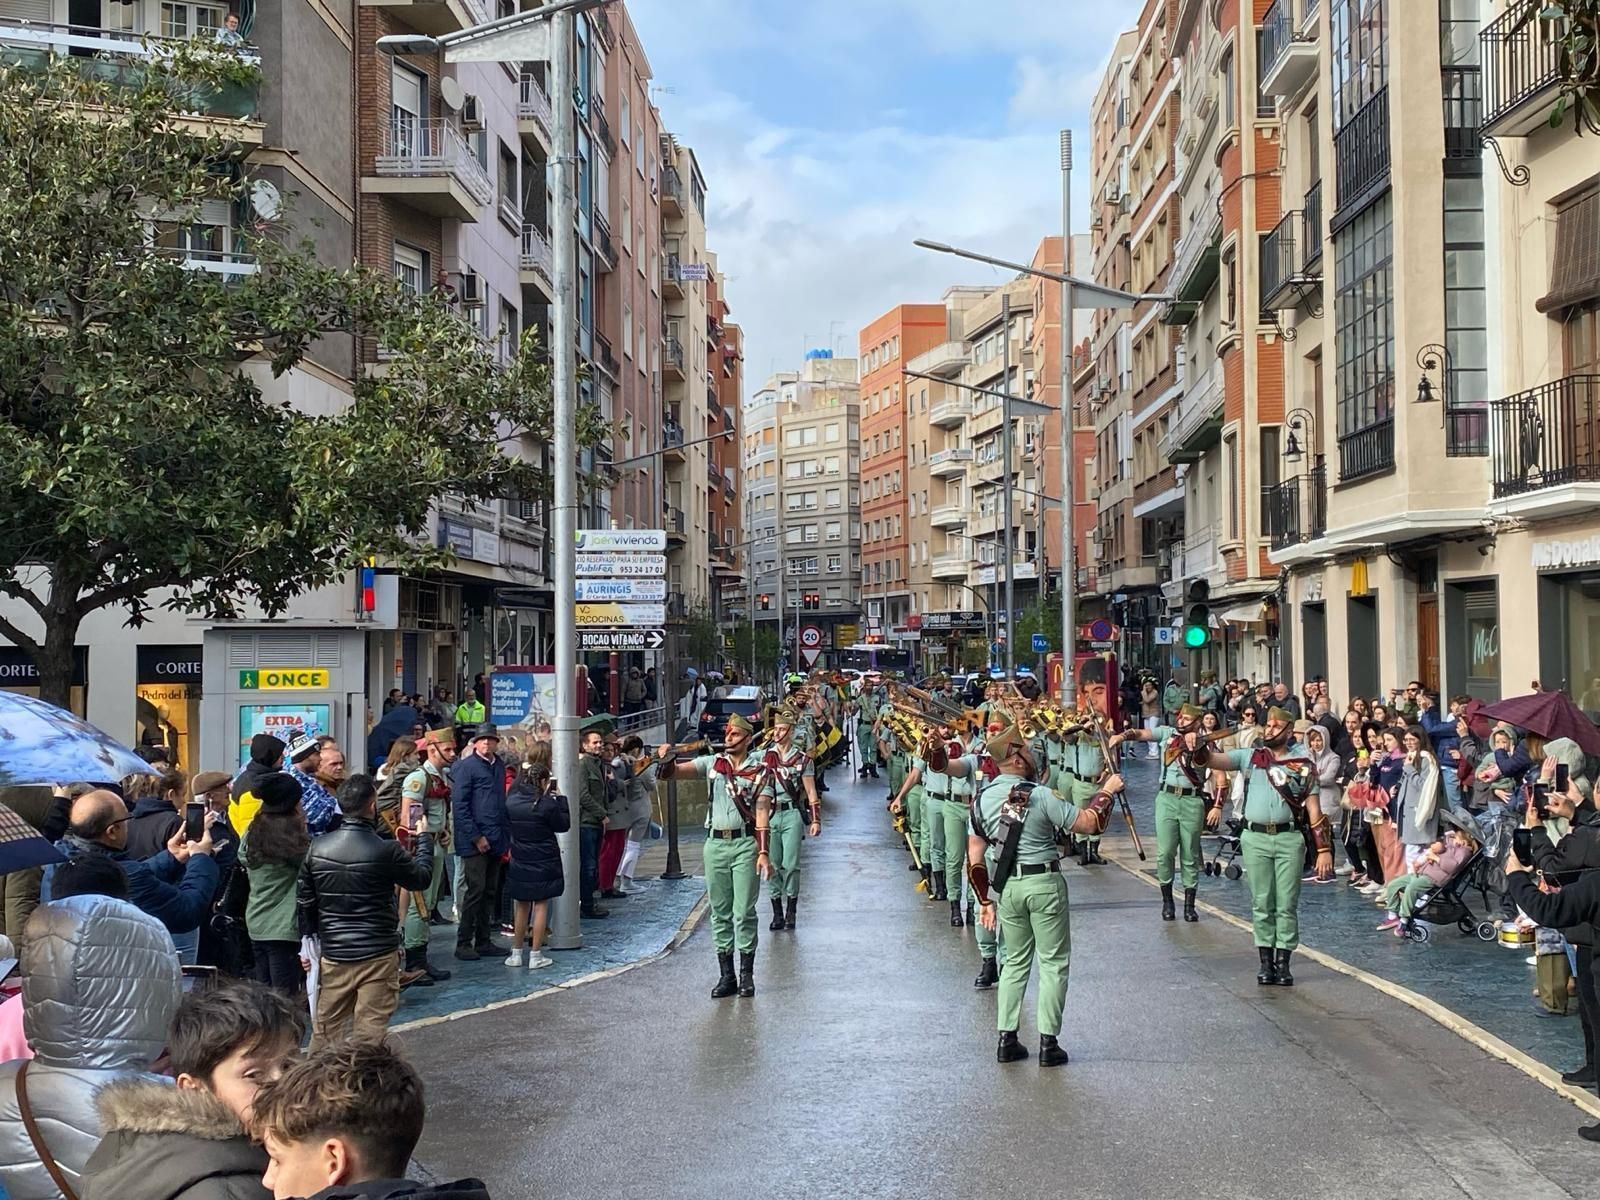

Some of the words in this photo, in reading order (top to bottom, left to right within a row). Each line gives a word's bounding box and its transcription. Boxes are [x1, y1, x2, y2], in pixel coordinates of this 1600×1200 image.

[1532, 536, 1600, 566] McDonal
[586, 586, 632, 594] AURINGIS
[582, 634, 609, 645] BOCAO
[156, 662, 201, 674] CORTE
[267, 673, 321, 686] ONCE
[142, 690, 167, 700] Pedro
[168, 689, 182, 699] del
[265, 716, 303, 726] EXTRA
